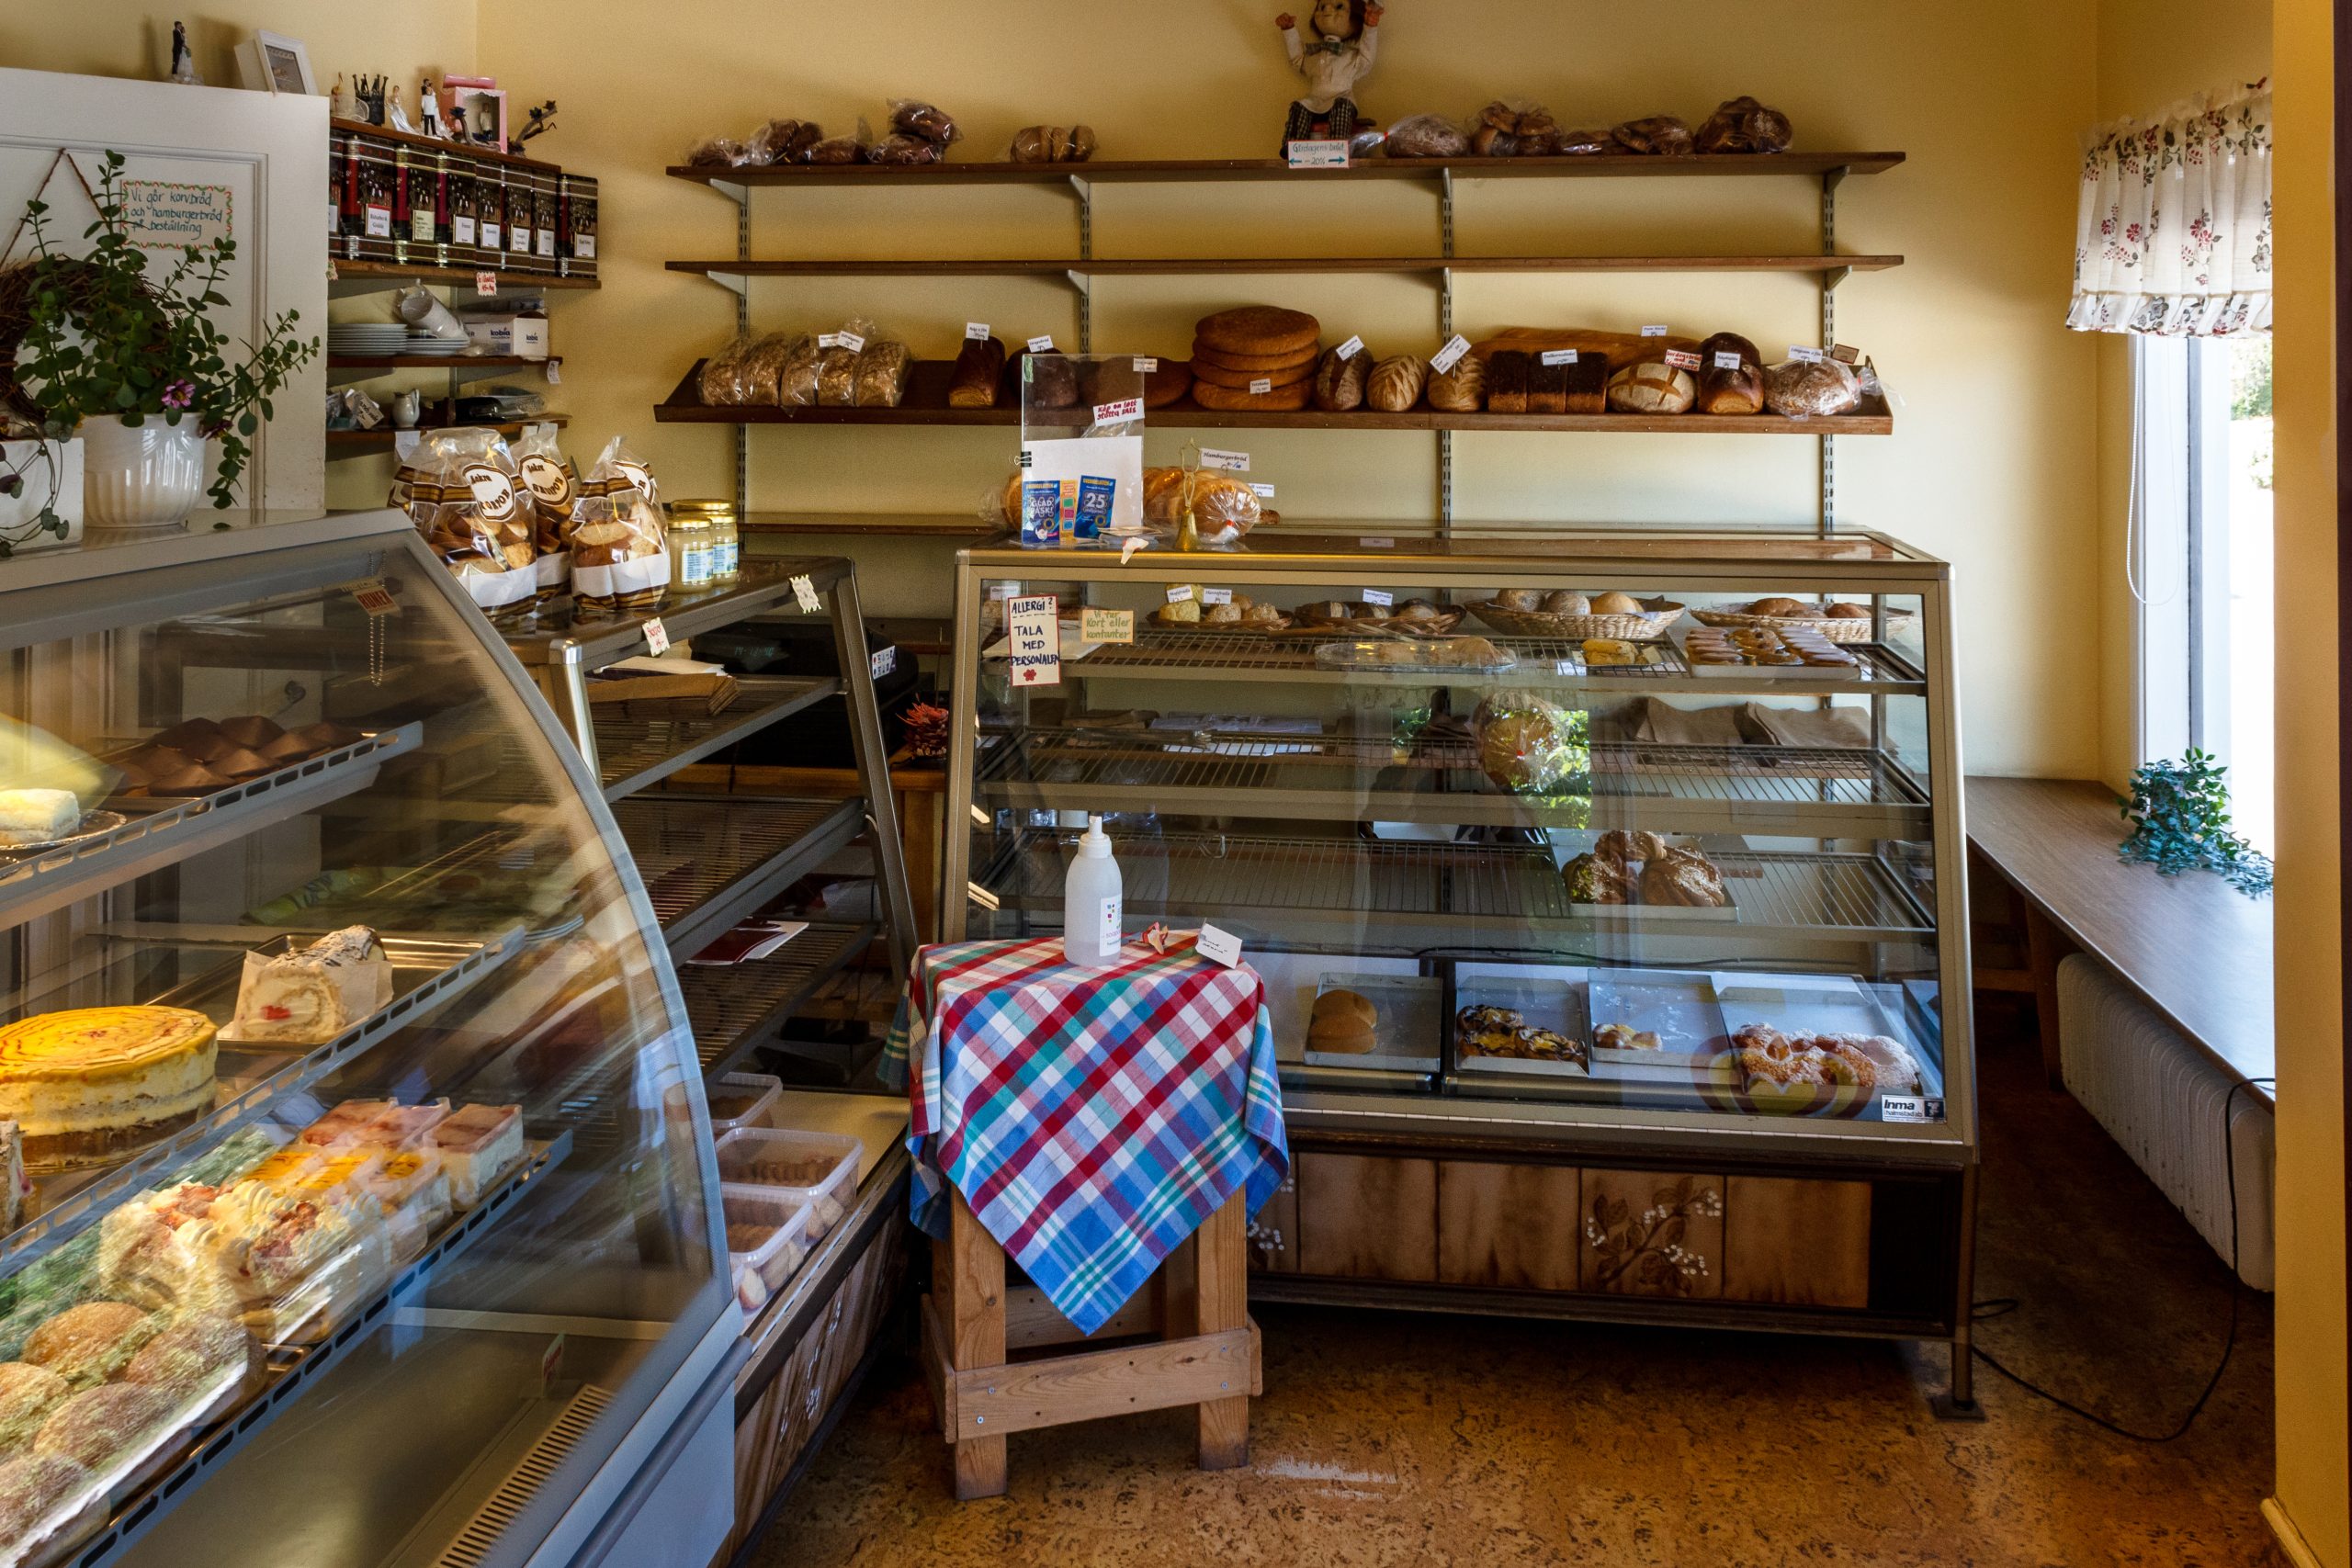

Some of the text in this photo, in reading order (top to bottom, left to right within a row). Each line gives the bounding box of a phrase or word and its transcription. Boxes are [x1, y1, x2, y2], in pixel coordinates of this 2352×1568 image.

[131, 188, 212, 209] Vi gör korvbröd
[131, 208, 222, 222] och hamburgerbröd
[151, 220, 202, 241] beställning
[491, 327, 510, 336] kobia
[1086, 492, 1105, 508] 25
[1110, 617, 1130, 626] eller
[1014, 625, 1043, 636] TALA
[1087, 630, 1130, 639] kontanter
[1023, 640, 1045, 650] MED
[1012, 654, 1059, 666] PERSONALEN
[1884, 1100, 1915, 1111] Inma
